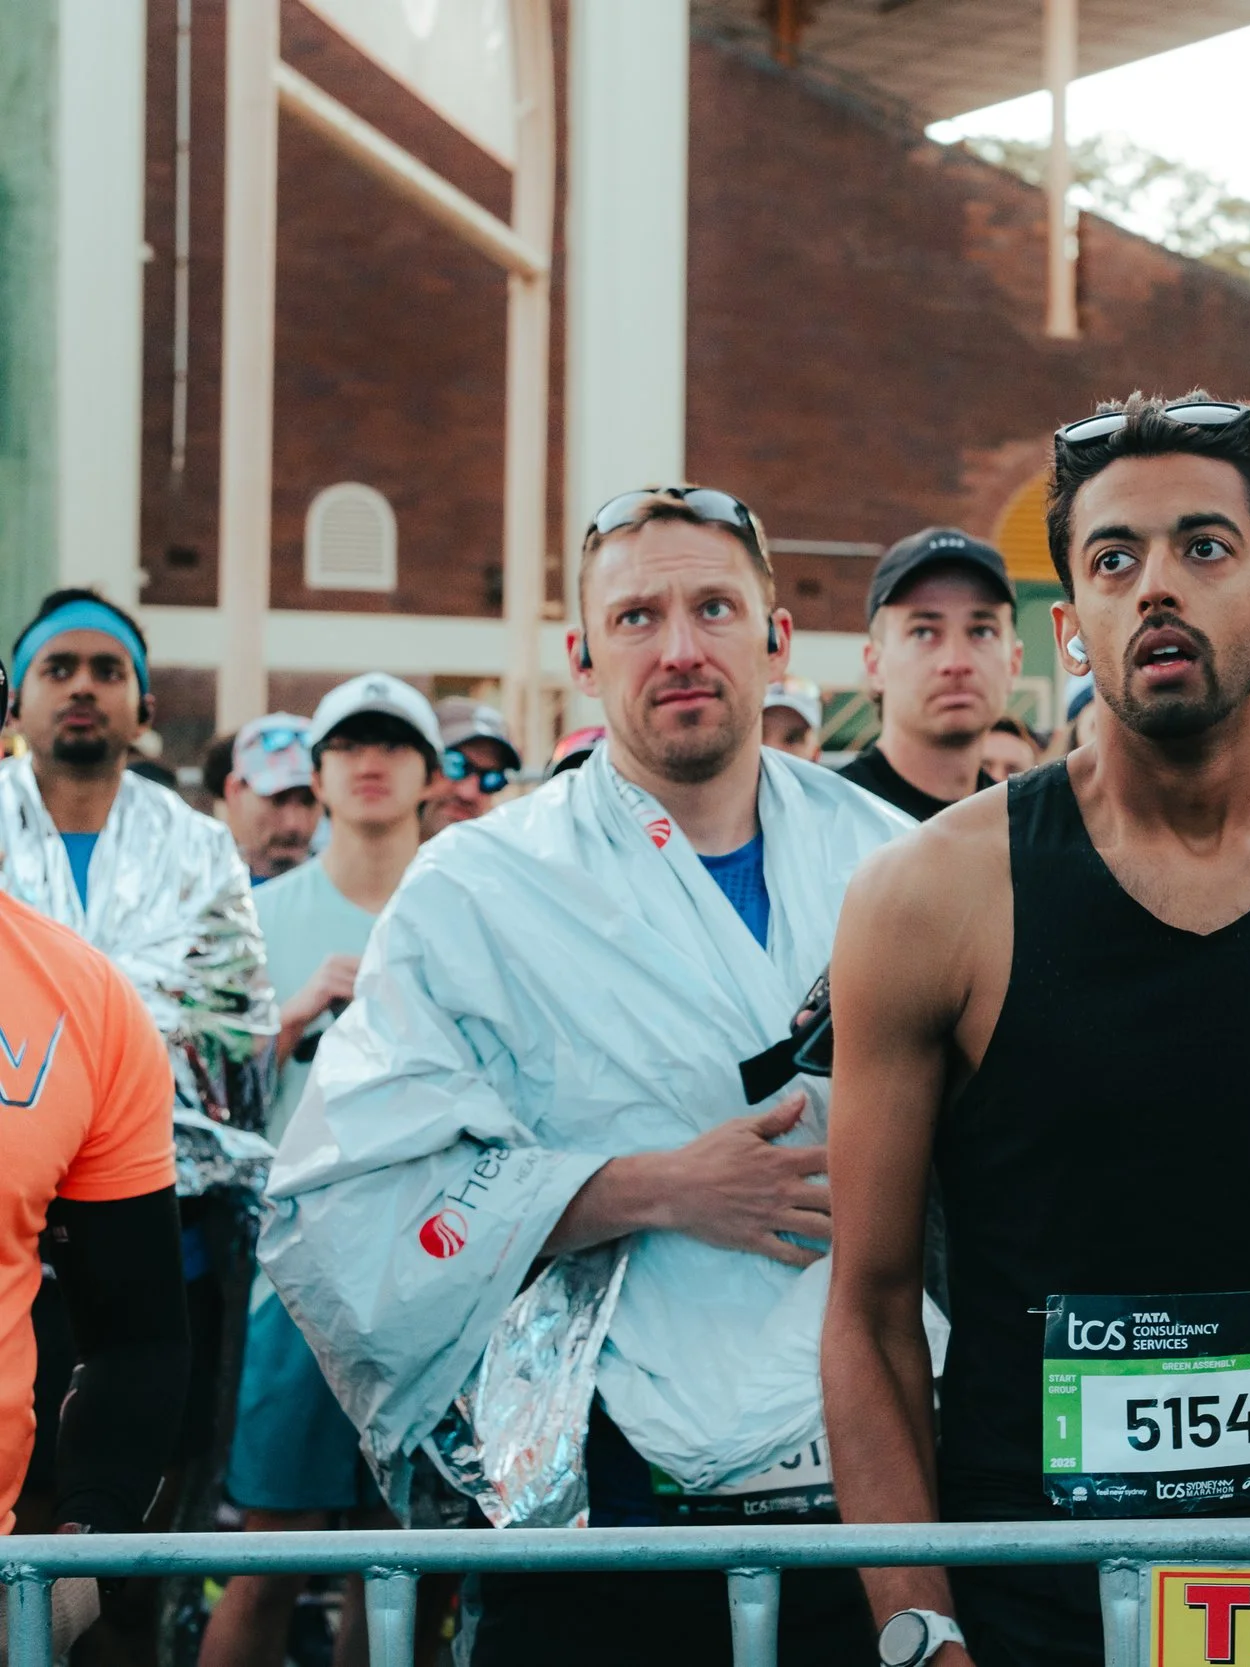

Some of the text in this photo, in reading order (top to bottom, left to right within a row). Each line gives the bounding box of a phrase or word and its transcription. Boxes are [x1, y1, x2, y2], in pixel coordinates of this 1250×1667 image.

[1132, 1312, 1171, 1323] TATA
[1067, 1311, 1126, 1351] tcs
[1132, 1323, 1219, 1337] CONSULTANCY
[1132, 1338, 1189, 1351] SERVICES
[1162, 1359, 1236, 1371] GREEN ASSEMBLY
[1048, 1374, 1077, 1383] START
[1048, 1385, 1078, 1394] GROUP
[1056, 1415, 1067, 1440] 1
[1050, 1457, 1077, 1468] 2025
[1156, 1480, 1218, 1499] tcs SYDNEY
[1186, 1486, 1235, 1497] MARATHON
